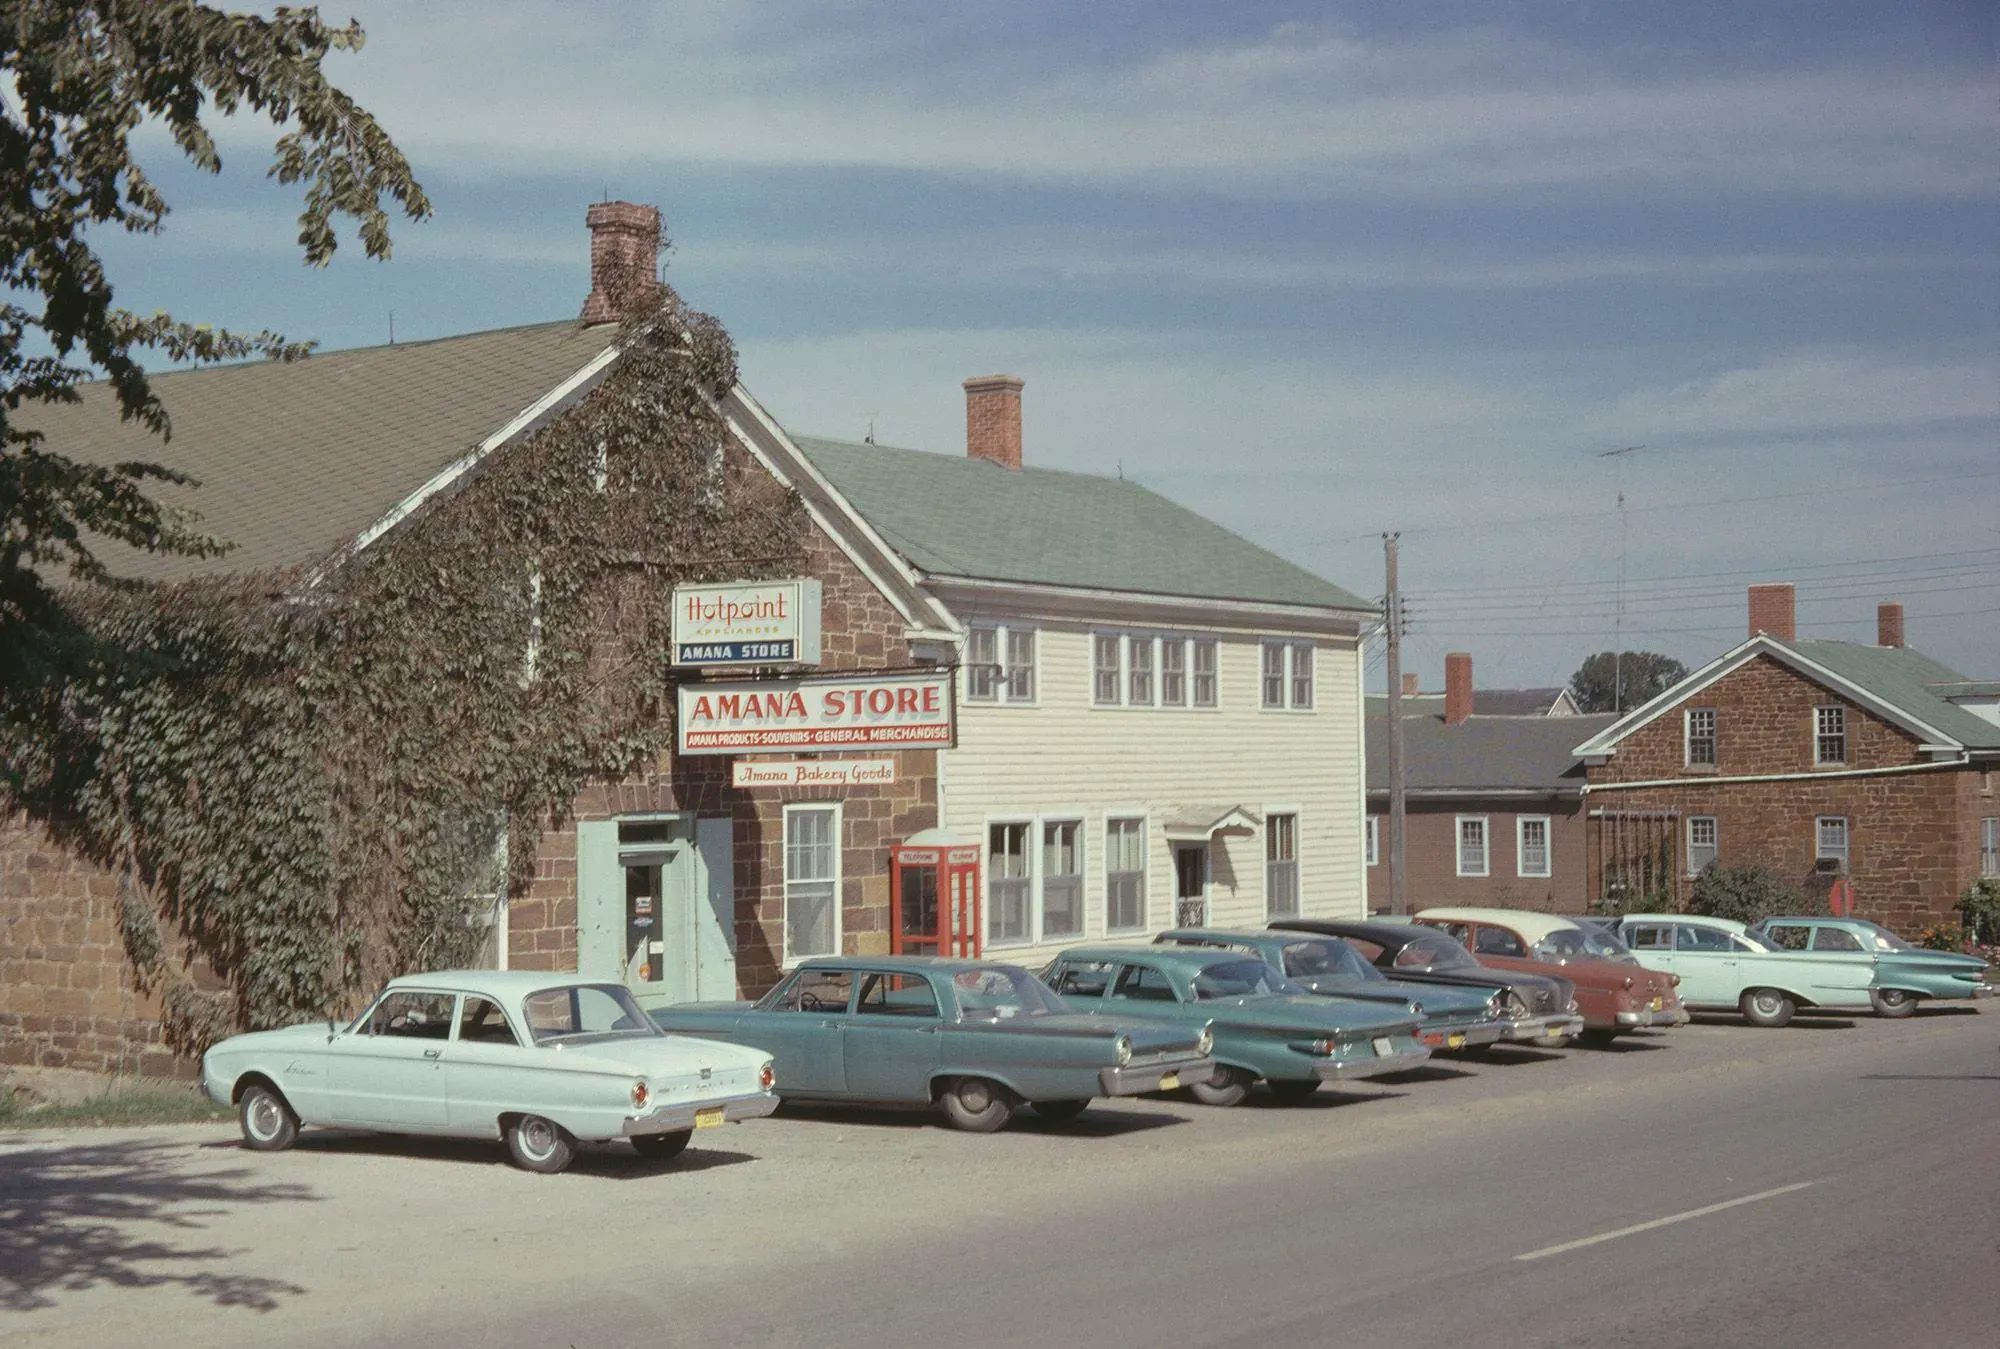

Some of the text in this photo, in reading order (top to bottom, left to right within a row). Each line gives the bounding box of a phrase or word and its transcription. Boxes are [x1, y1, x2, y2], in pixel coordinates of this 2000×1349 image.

[686, 593, 787, 625] Hotpoint
[696, 625, 780, 636] APPLIANCES
[682, 642, 790, 660] AMANA STORE
[692, 687, 941, 721] AMANA STORE
[688, 734, 718, 746] AMANA
[815, 729, 868, 743] GENERAL
[870, 727, 948, 741] MERCHANDISE
[739, 761, 892, 785] Amana Bakery Goods
